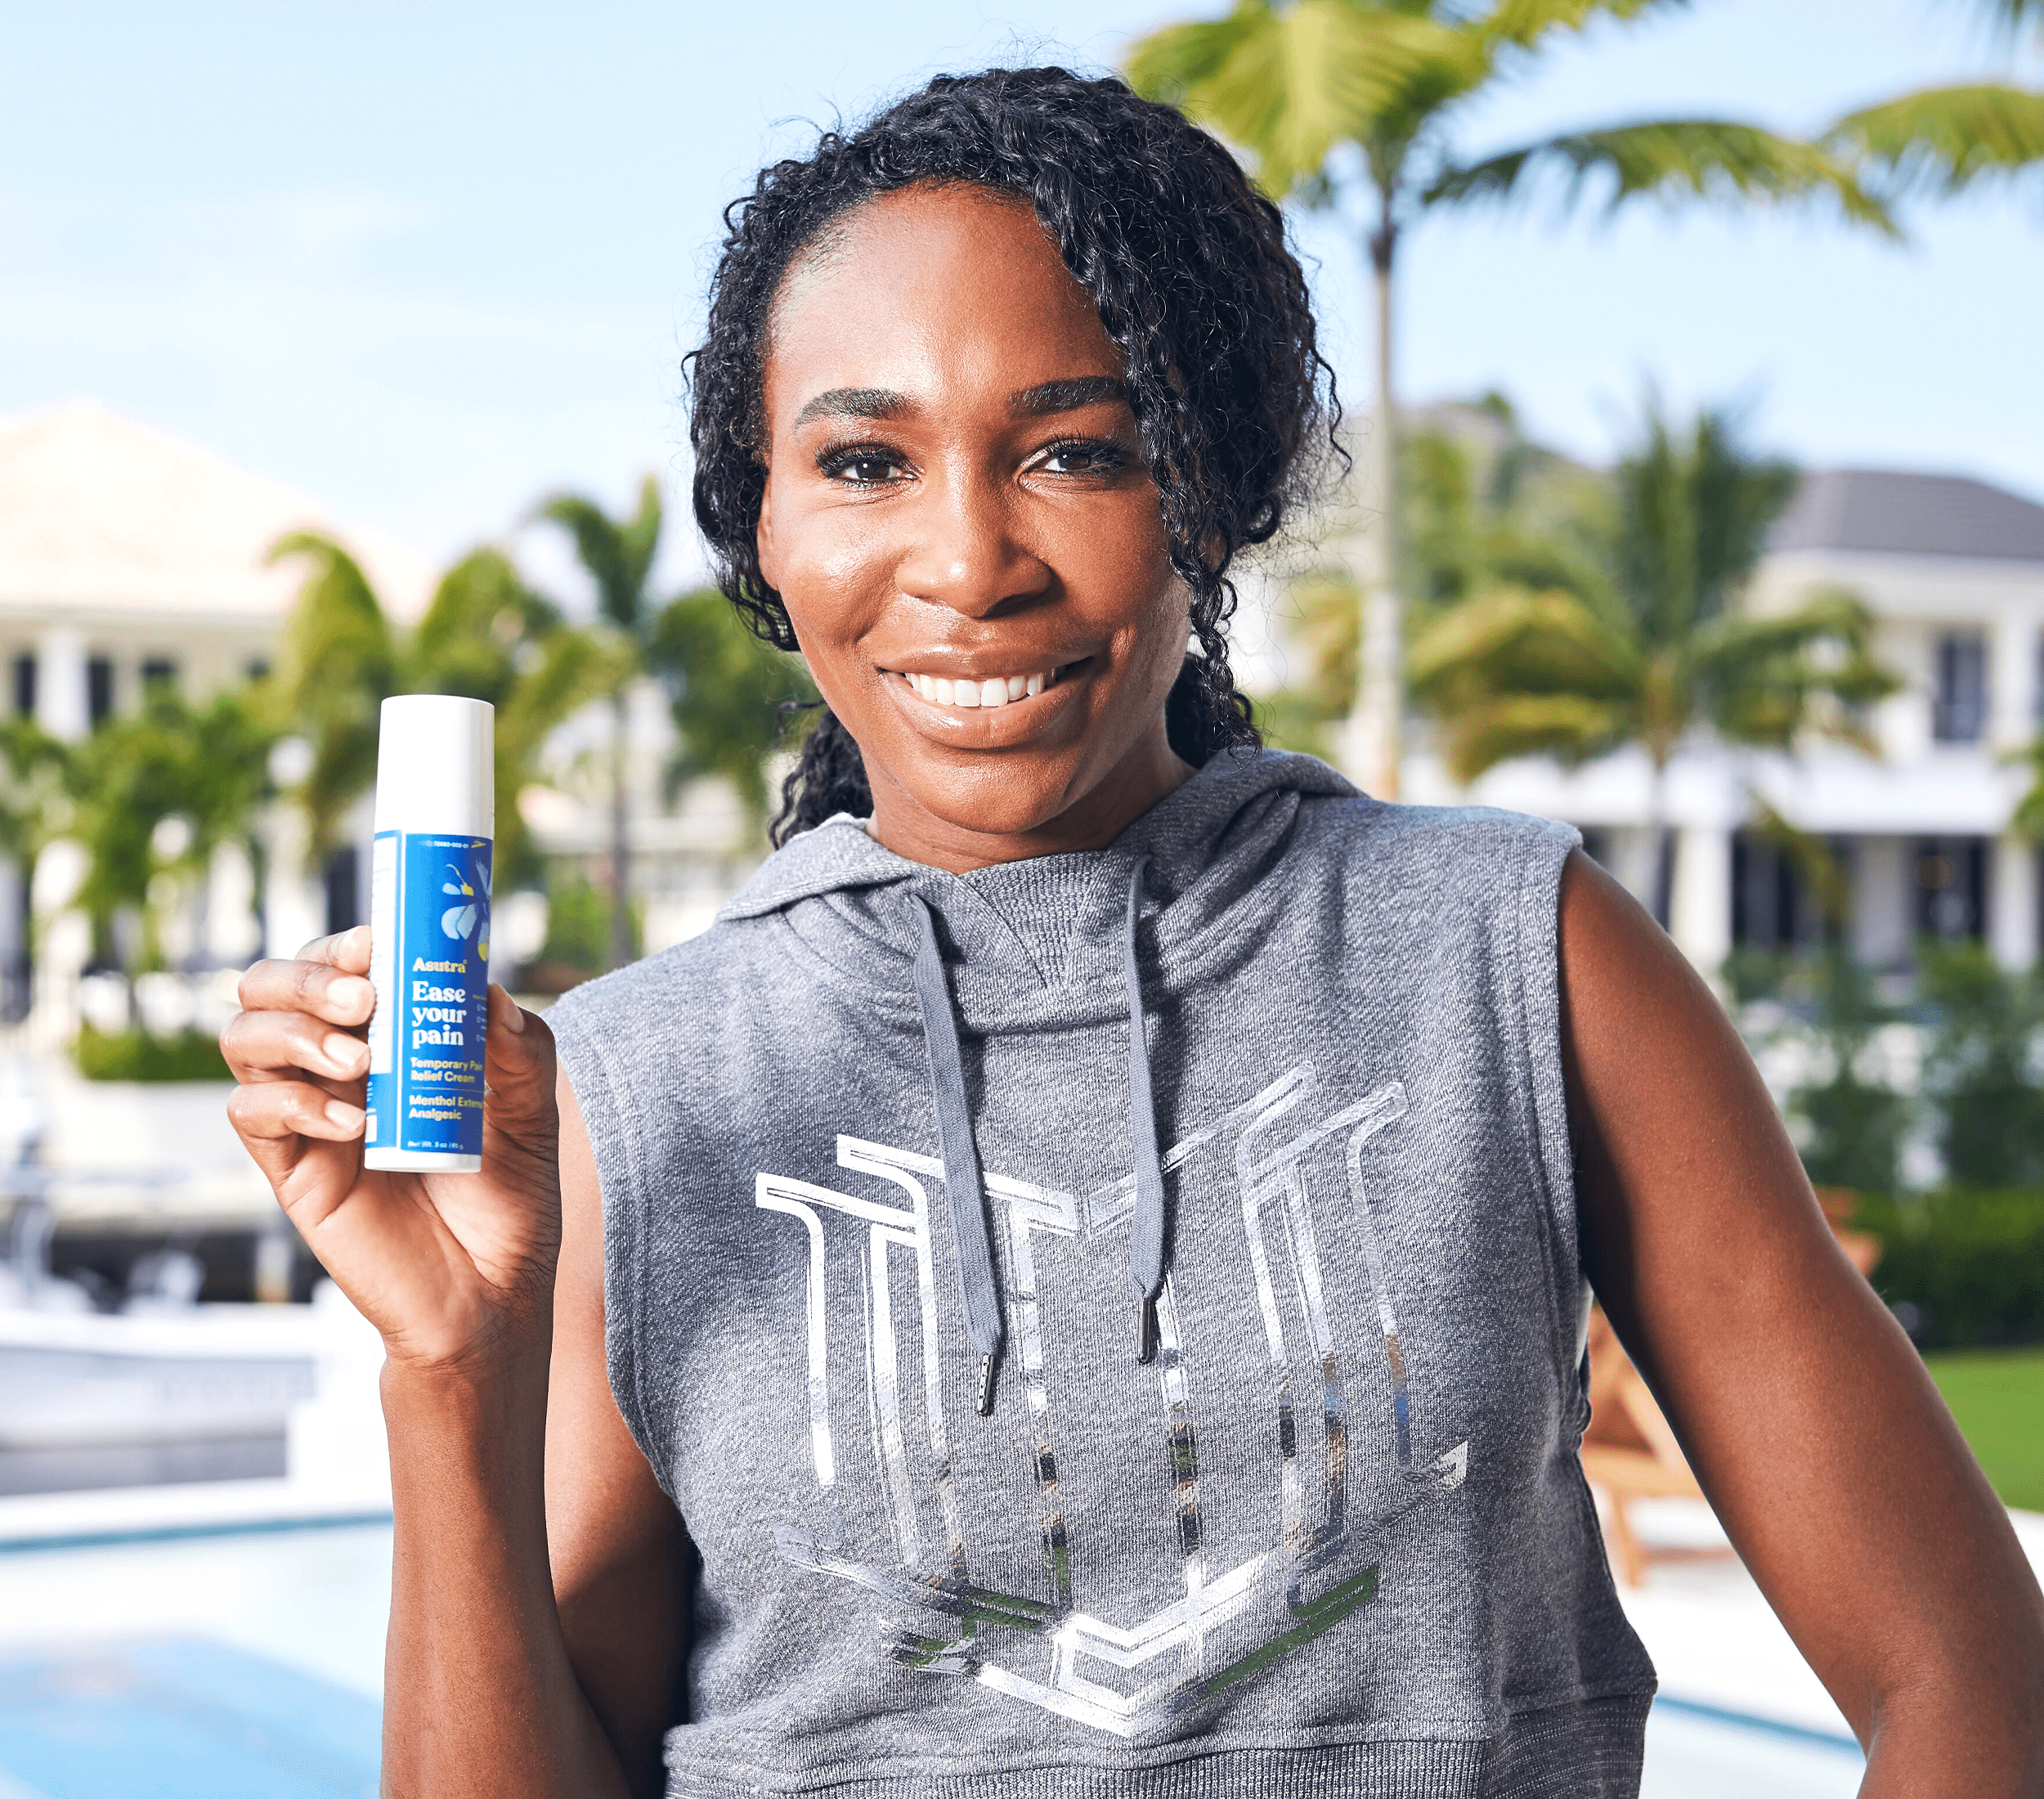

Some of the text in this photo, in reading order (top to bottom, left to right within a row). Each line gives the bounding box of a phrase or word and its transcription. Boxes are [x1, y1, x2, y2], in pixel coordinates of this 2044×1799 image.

[412, 980, 466, 1003] Ease
[411, 1007, 467, 1027] your
[411, 1024, 464, 1049] pain
[410, 1057, 468, 1071] Temporary
[410, 1070, 475, 1083] Relief Cream
[409, 1094, 455, 1106] Menthol
[409, 1107, 462, 1121] Analgesic
